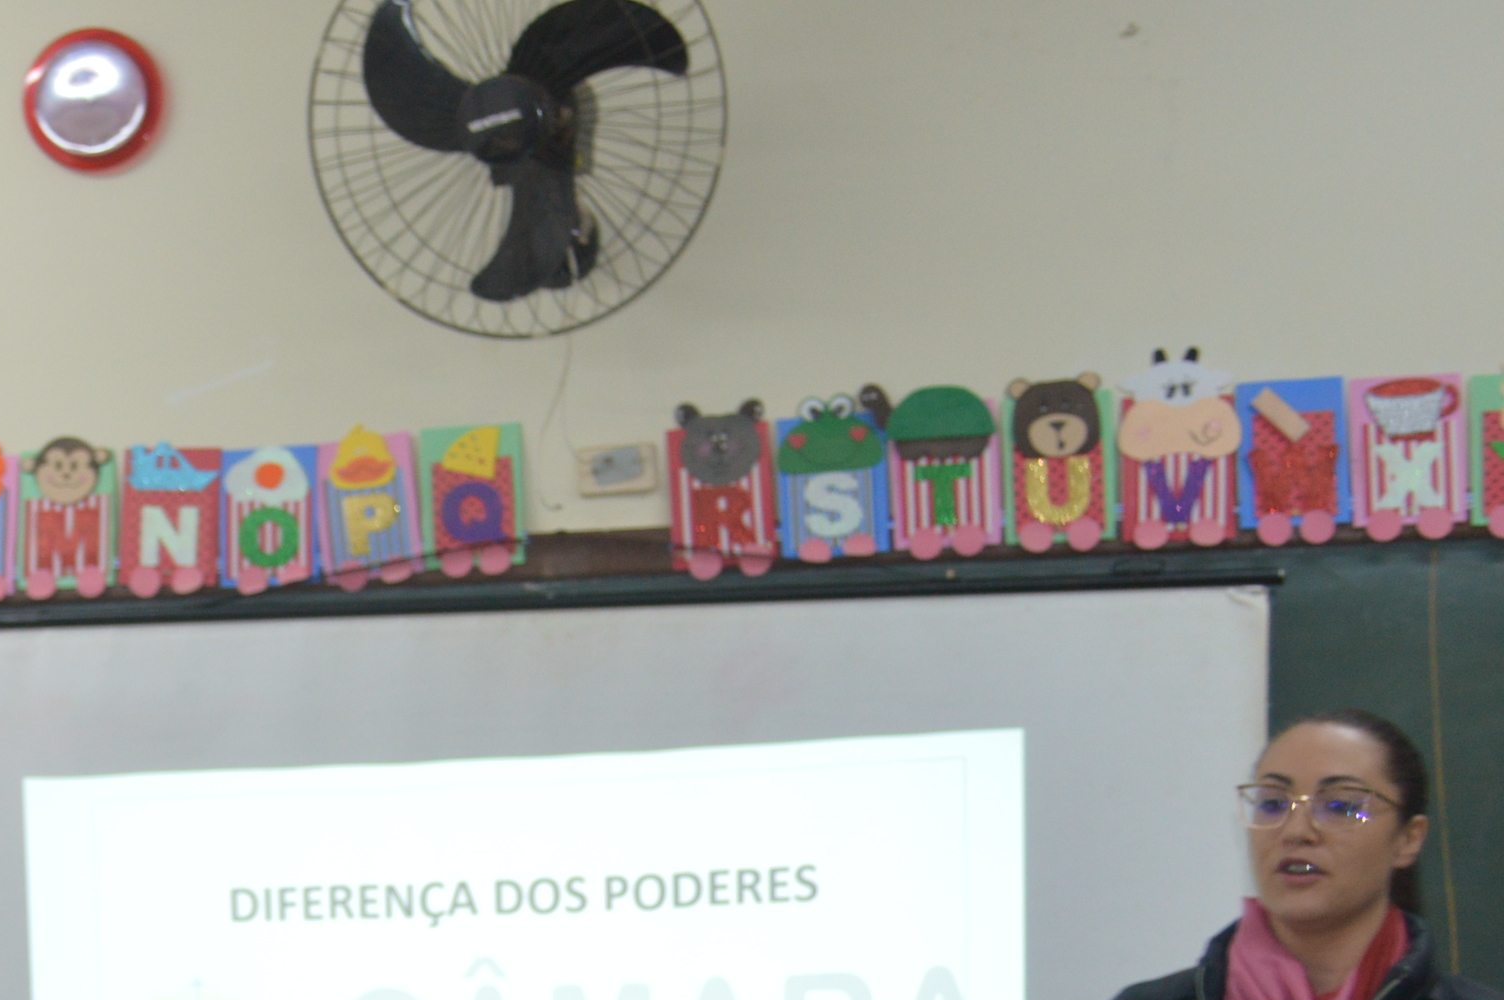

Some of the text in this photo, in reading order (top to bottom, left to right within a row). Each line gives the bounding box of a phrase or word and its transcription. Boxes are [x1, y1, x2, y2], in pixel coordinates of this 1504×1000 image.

[37, 506, 100, 568] M
[139, 506, 198, 568] N
[239, 507, 300, 567] O
[343, 493, 397, 555] P
[441, 482, 503, 543] Q
[691, 484, 760, 549] R
[803, 472, 864, 537] S
[914, 464, 972, 526] T
[1024, 458, 1090, 526] U
[1144, 459, 1214, 524] V
[1373, 441, 1445, 509] X
[230, 864, 818, 928] DIFERENÇA DOS PODERES
